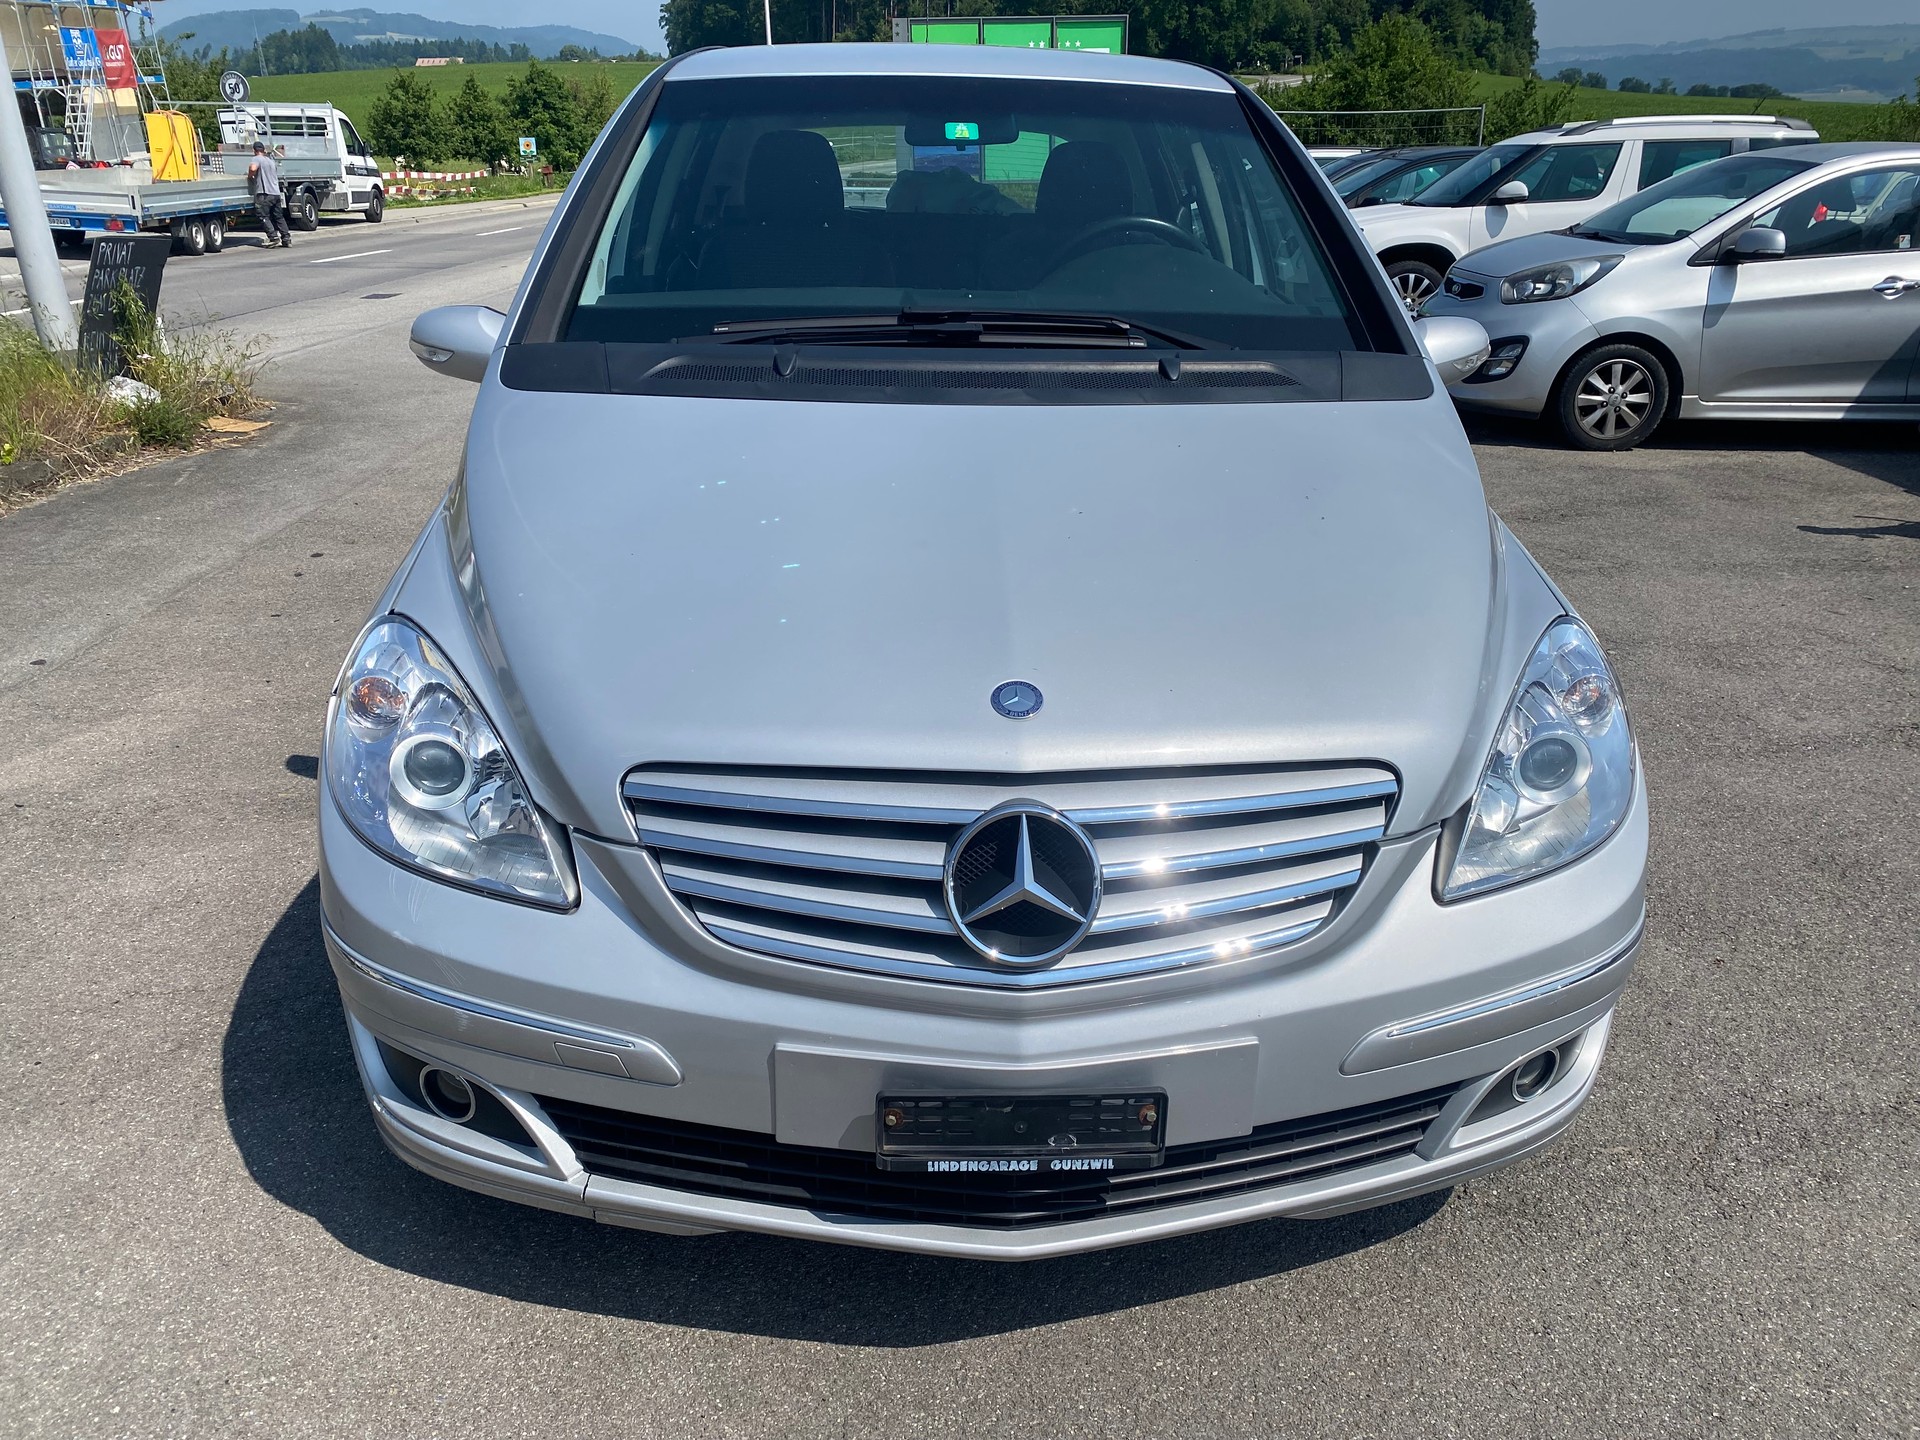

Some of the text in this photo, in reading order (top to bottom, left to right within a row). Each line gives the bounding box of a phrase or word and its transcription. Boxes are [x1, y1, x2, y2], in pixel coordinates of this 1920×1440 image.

[228, 82, 240, 95] 50
[96, 241, 135, 266] PRIVAT
[927, 1158, 1115, 1172] LINDENGARAGE GUNZWIL
